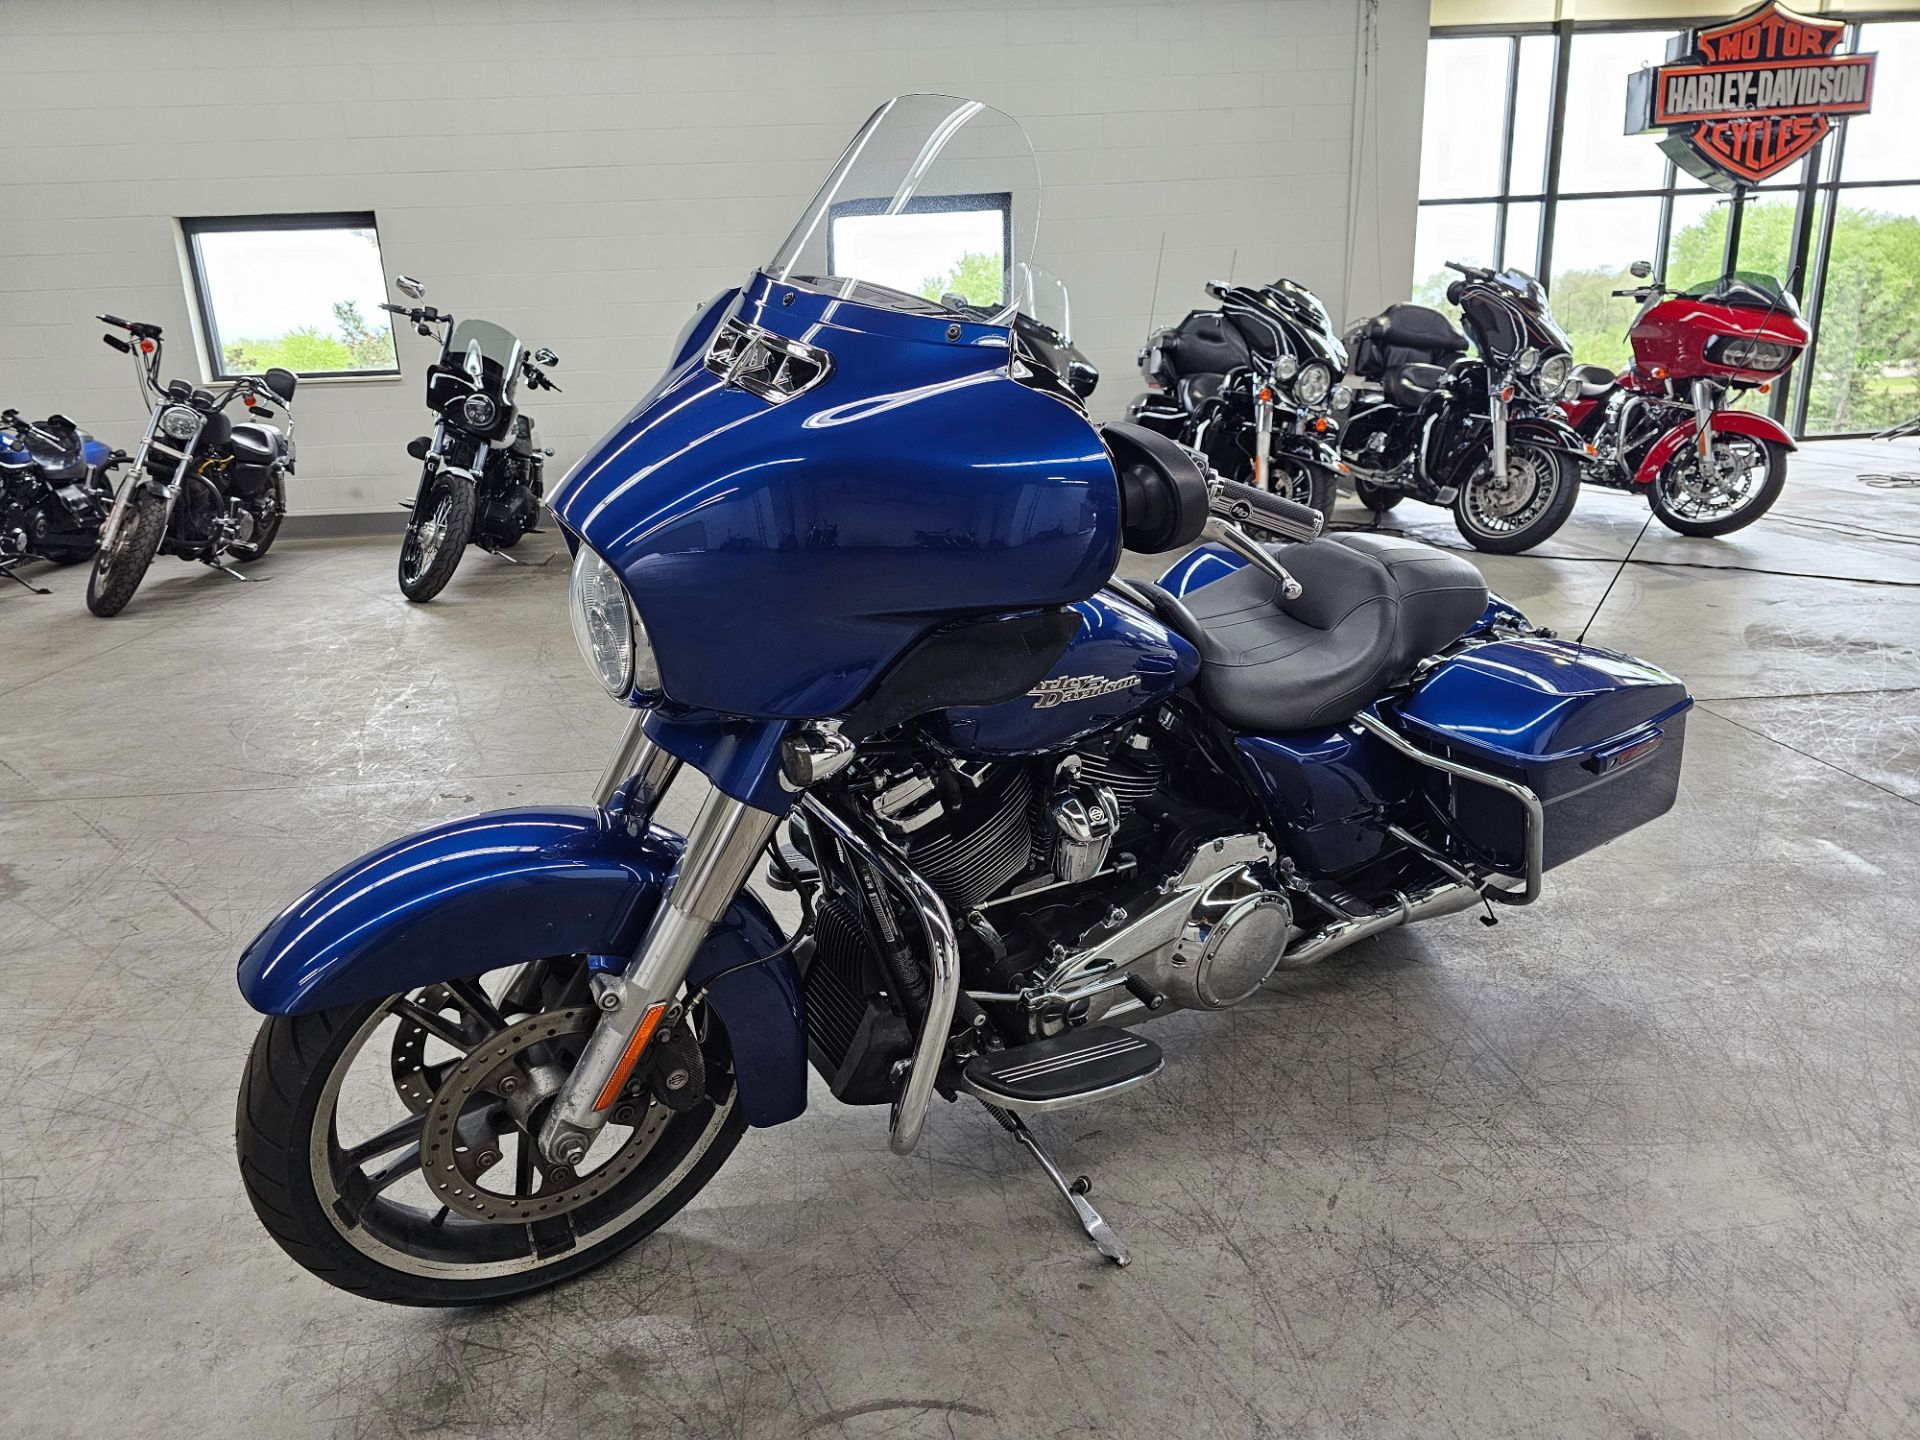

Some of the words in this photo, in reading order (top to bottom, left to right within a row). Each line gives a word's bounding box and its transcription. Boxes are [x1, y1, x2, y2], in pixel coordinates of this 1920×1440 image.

[1719, 19, 1822, 61] MOTOR
[1667, 64, 1866, 113] HARLEY-DAVIDSON
[1711, 117, 1814, 170] CYCLES
[1033, 675, 1104, 691] rley
